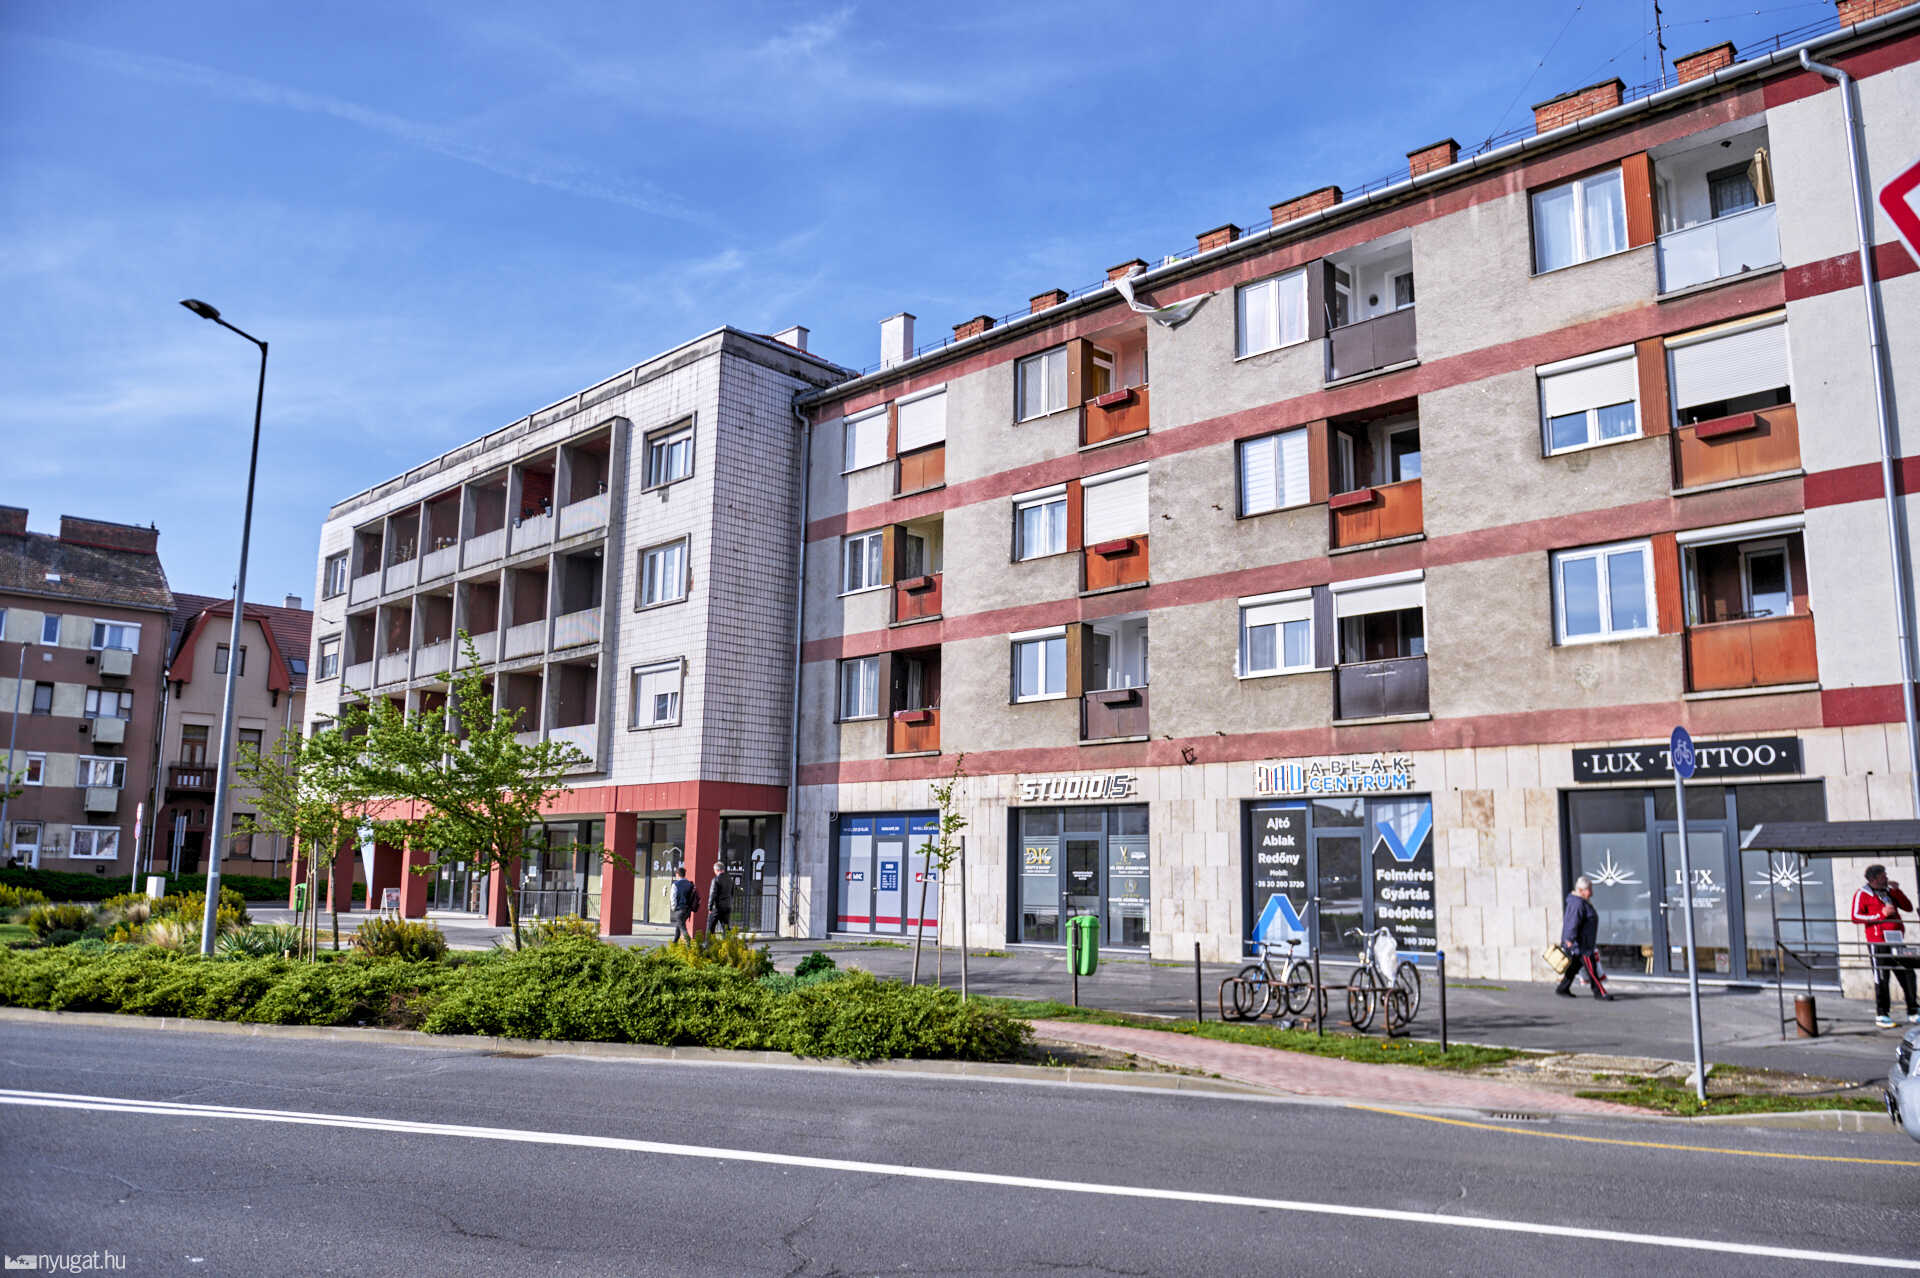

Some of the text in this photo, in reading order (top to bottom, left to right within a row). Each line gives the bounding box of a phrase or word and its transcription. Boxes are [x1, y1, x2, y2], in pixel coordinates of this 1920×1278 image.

[1310, 757, 1406, 775] ABLAK
[1592, 744, 1776, 774] LUX TTTOO
[1309, 773, 1407, 790] CENTRUM
[1266, 817, 1290, 830] Ajtó
[1262, 835, 1295, 847] Ablak
[1258, 852, 1299, 866] Redőny
[1376, 868, 1434, 881] Felmérés
[1381, 887, 1430, 902] Gyártás
[1379, 907, 1434, 921] Beépítés
